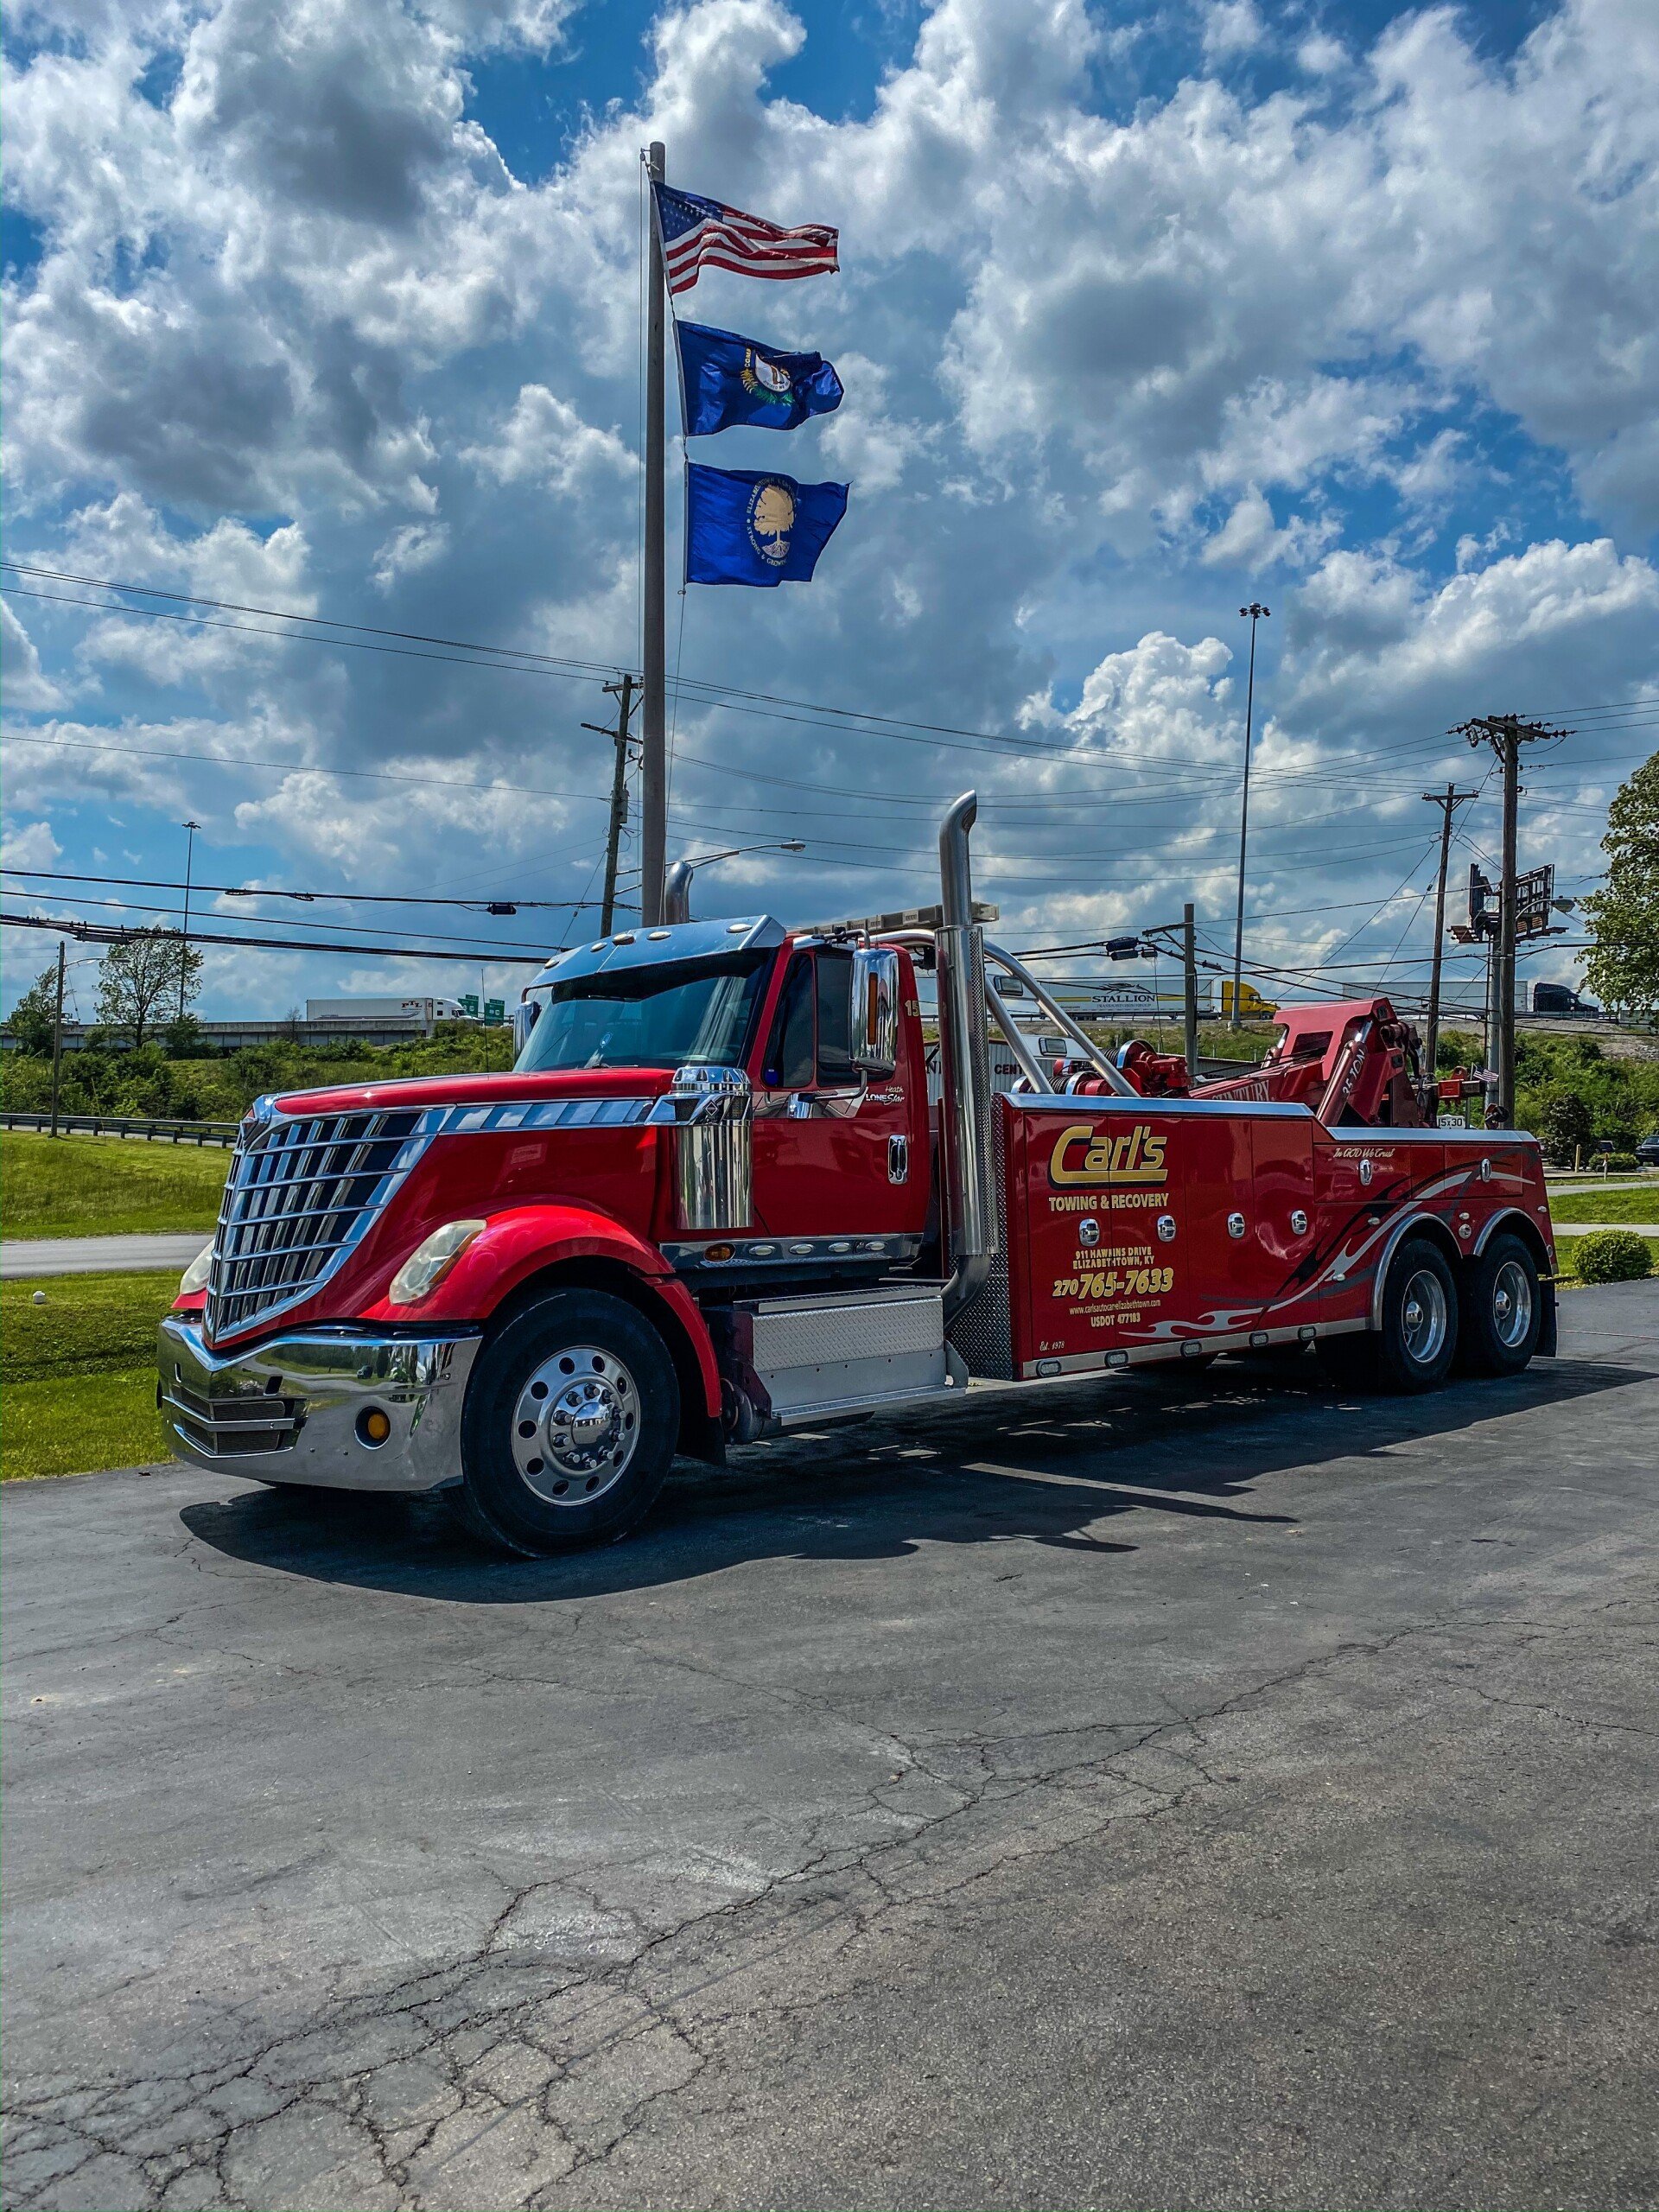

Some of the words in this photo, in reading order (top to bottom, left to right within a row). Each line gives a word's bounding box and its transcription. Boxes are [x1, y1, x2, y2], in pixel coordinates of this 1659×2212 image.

[1091, 995, 1156, 1003] STALLION
[905, 1000, 920, 1017] 15
[994, 1064, 1024, 1075] CENT
[1342, 1077, 1353, 1096] 35
[1350, 1048, 1365, 1080] TON
[1050, 1125, 1168, 1184] Carl's
[1332, 1147, 1343, 1158] In
[1343, 1147, 1363, 1158] GOD
[1363, 1147, 1375, 1158] We
[1374, 1147, 1396, 1158] Trust
[1048, 1195, 1097, 1211] TOWING
[1100, 1195, 1109, 1209] &
[1111, 1192, 1169, 1209] RECOVERY
[1075, 1249, 1089, 1260] 911
[1128, 1246, 1152, 1256] DRIVE
[1144, 1255, 1155, 1265] KY
[1052, 1279, 1079, 1297] 270
[1078, 1267, 1174, 1300] 765-7633
[1090, 1315, 1115, 1327] USDOT
[1052, 1340, 1065, 1350] 1978
